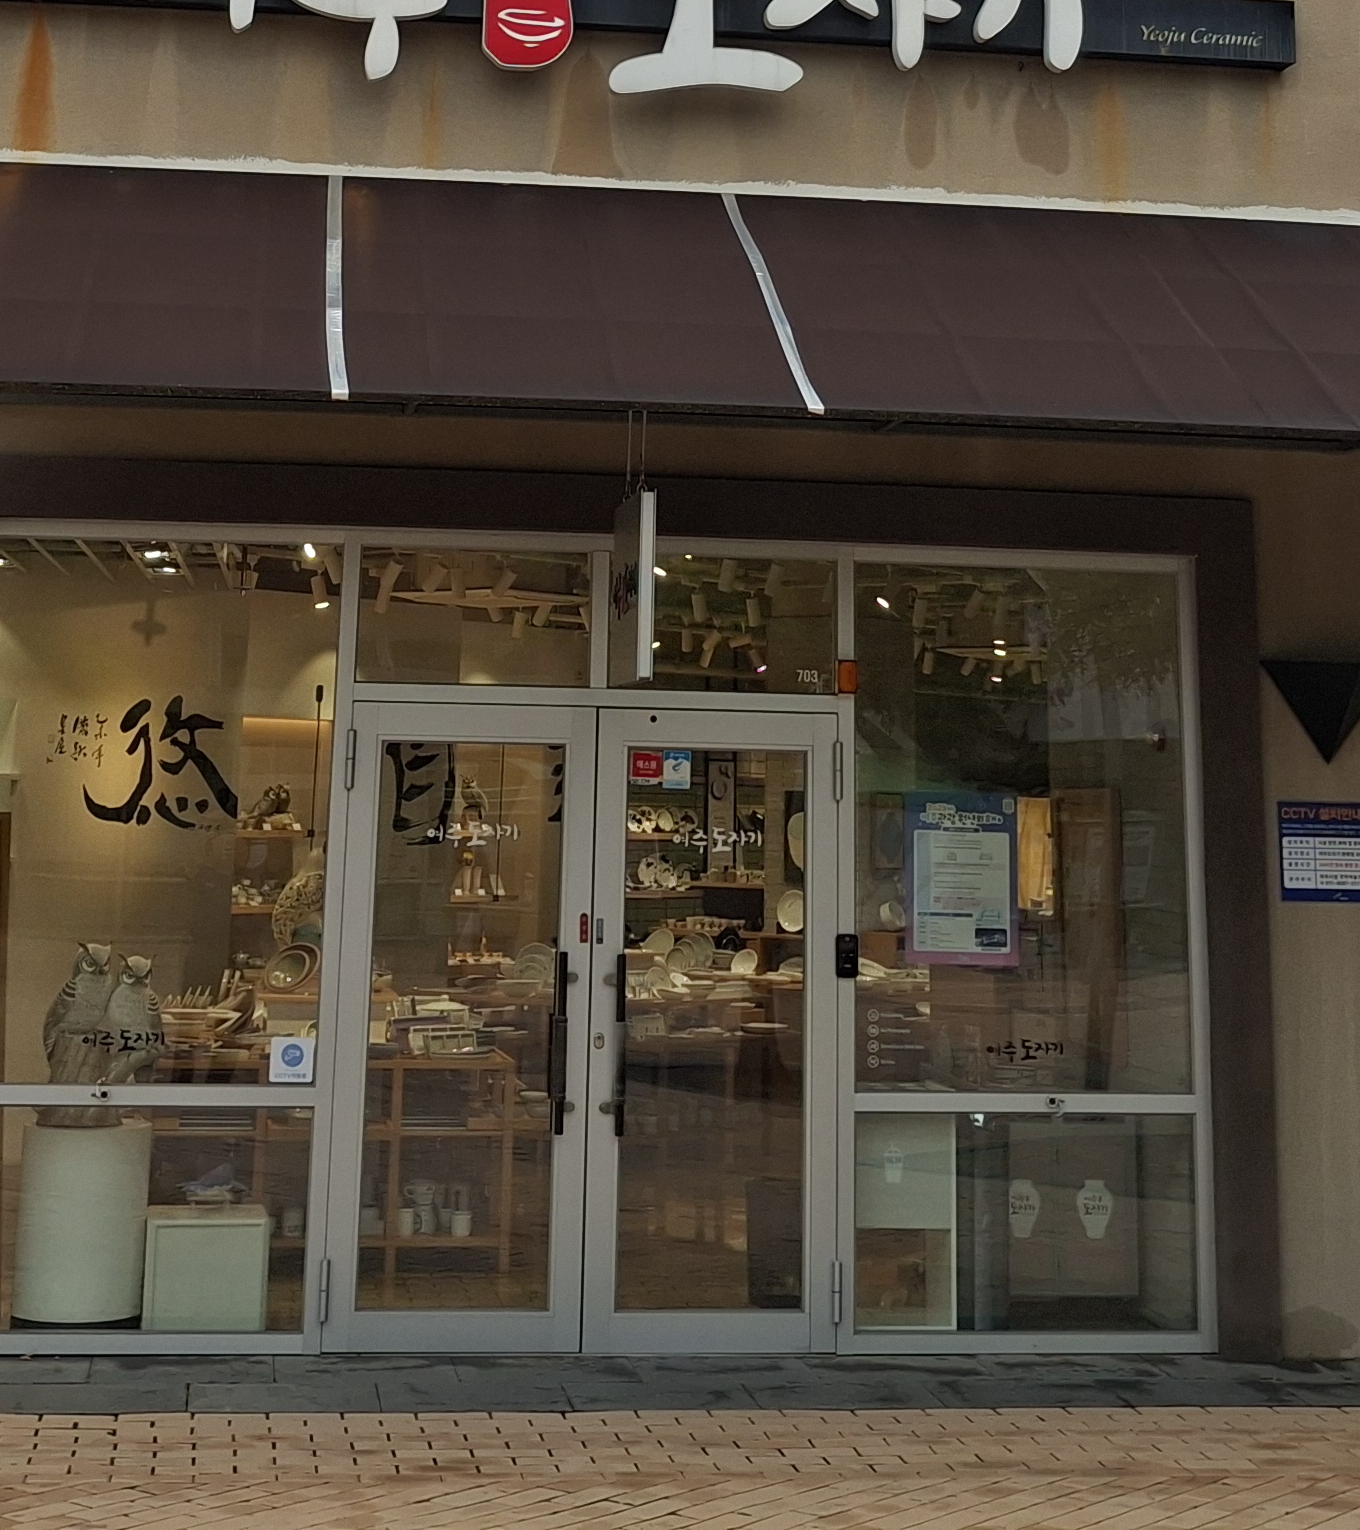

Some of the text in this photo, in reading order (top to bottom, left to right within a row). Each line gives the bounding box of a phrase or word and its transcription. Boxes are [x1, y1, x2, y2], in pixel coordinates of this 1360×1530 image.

[1140, 24, 1264, 48] Yeoju Ceramic
[796, 669, 818, 682] 703
[1281, 807, 1316, 819] CCTV
[426, 821, 519, 848] 여주 도자기
[672, 827, 764, 856] 여주 도자기
[81, 1029, 166, 1054] 여주 도자기
[1020, 1038, 1064, 1061] 도자기
